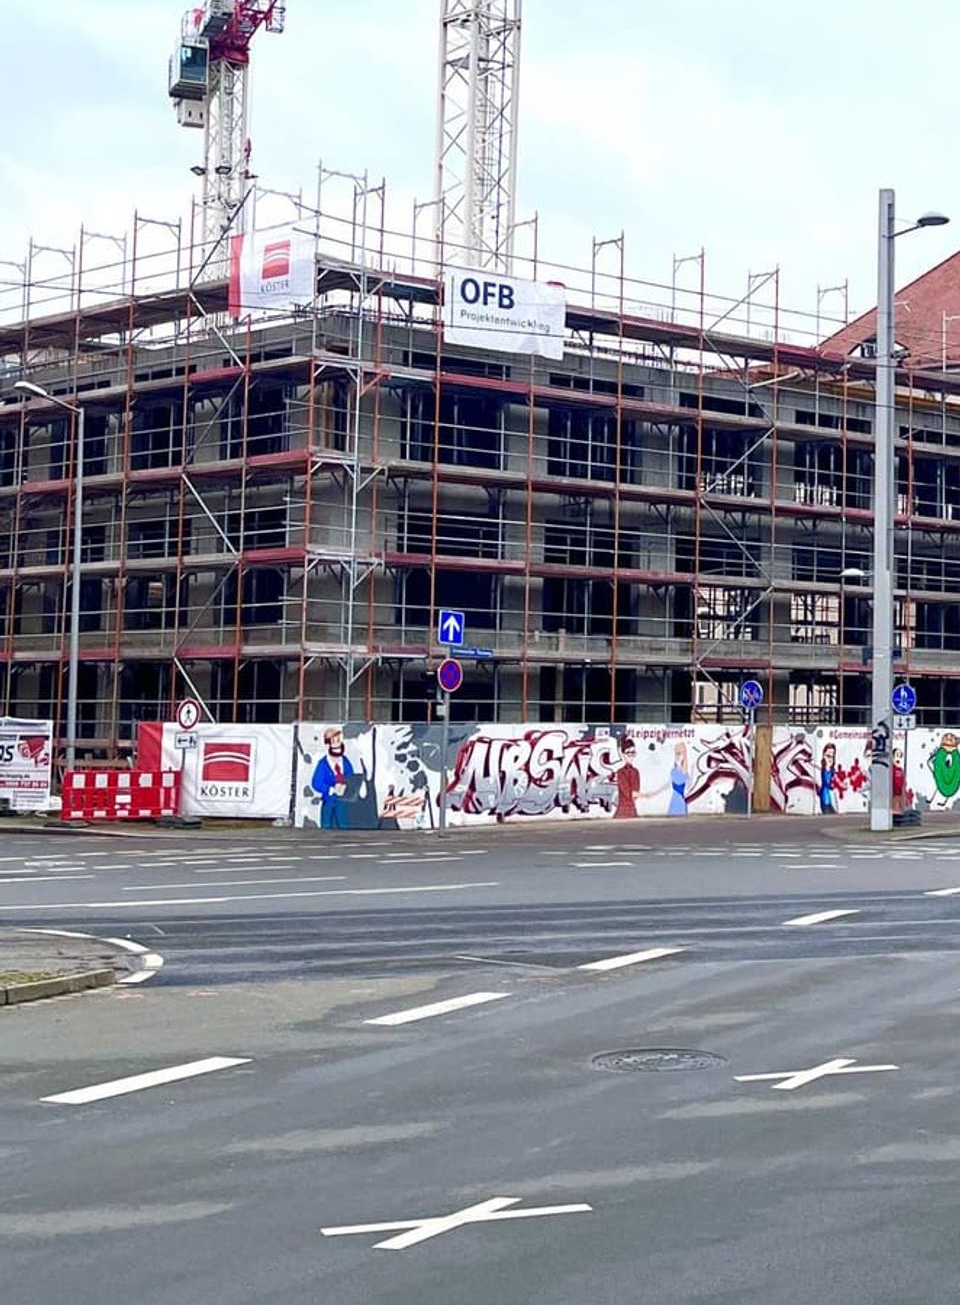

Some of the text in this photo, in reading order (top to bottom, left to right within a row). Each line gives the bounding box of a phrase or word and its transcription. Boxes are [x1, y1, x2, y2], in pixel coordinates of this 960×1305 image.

[460, 278, 515, 310] OFB
[460, 309, 551, 333] Projektentwicklng
[200, 785, 250, 797] KÖSTER
